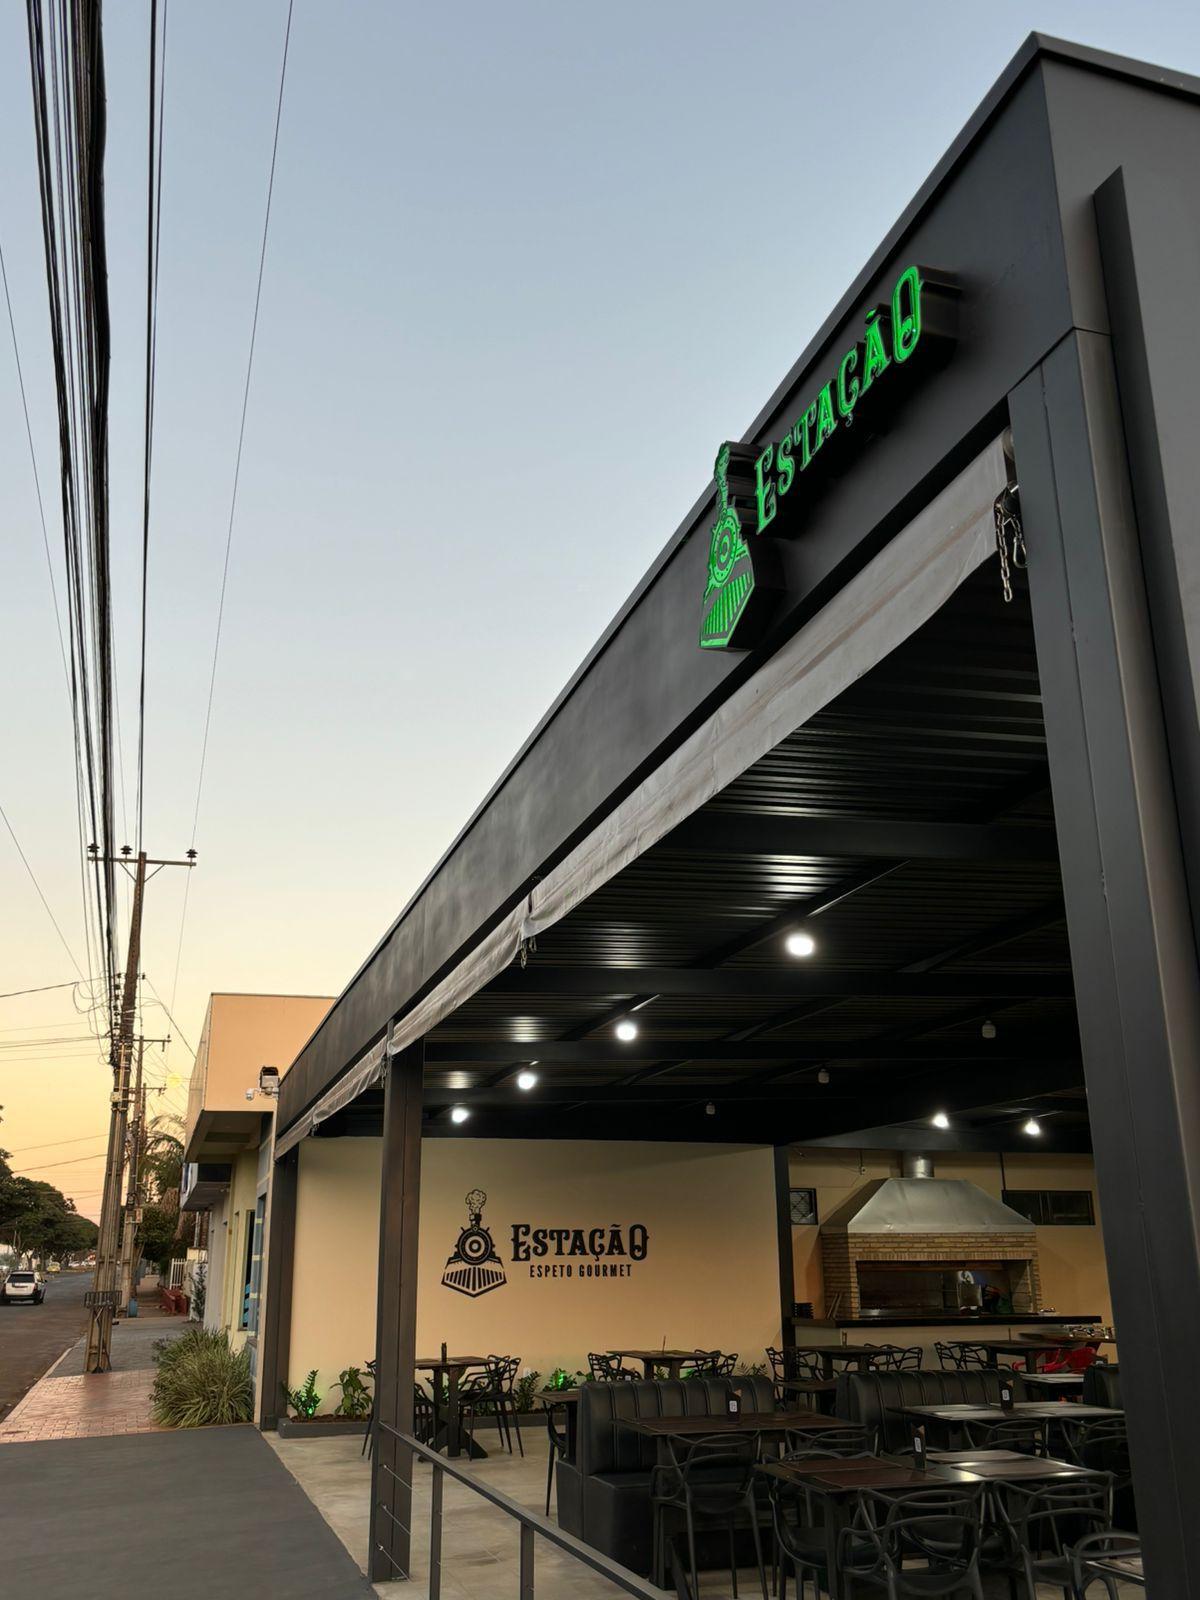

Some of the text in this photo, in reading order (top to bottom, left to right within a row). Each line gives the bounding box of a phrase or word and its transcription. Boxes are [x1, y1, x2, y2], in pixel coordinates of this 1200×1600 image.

[754, 265, 925, 535] ESTAÇÃO
[511, 1224, 650, 1261] ESTAÇÃO
[529, 1264, 632, 1277] ESPETO GOURMET
